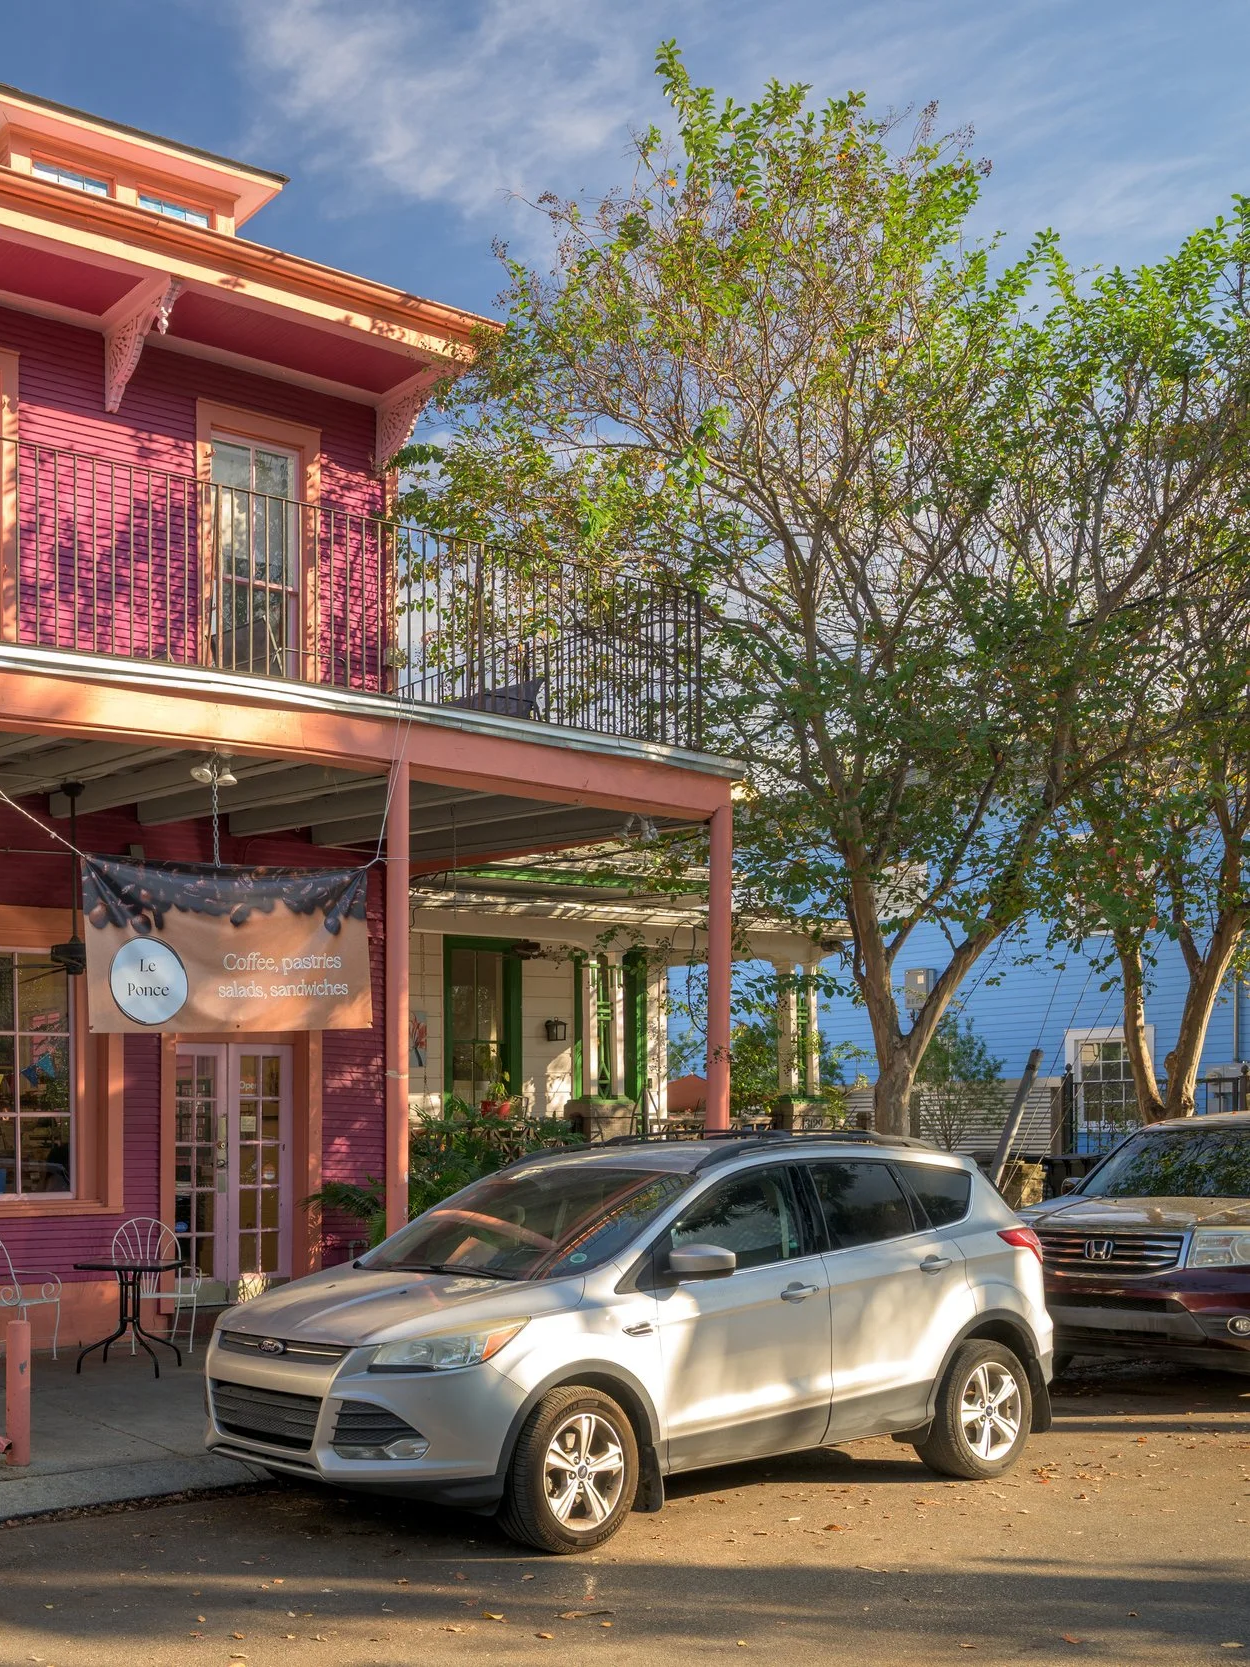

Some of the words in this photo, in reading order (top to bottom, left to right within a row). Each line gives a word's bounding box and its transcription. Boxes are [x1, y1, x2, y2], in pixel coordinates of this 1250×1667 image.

[139, 958, 157, 973] Le
[223, 952, 279, 974] Coffee,
[282, 952, 342, 975] pastries
[127, 982, 170, 997] Ponce
[218, 981, 268, 1000] salads,
[270, 979, 349, 998] sandwiches
